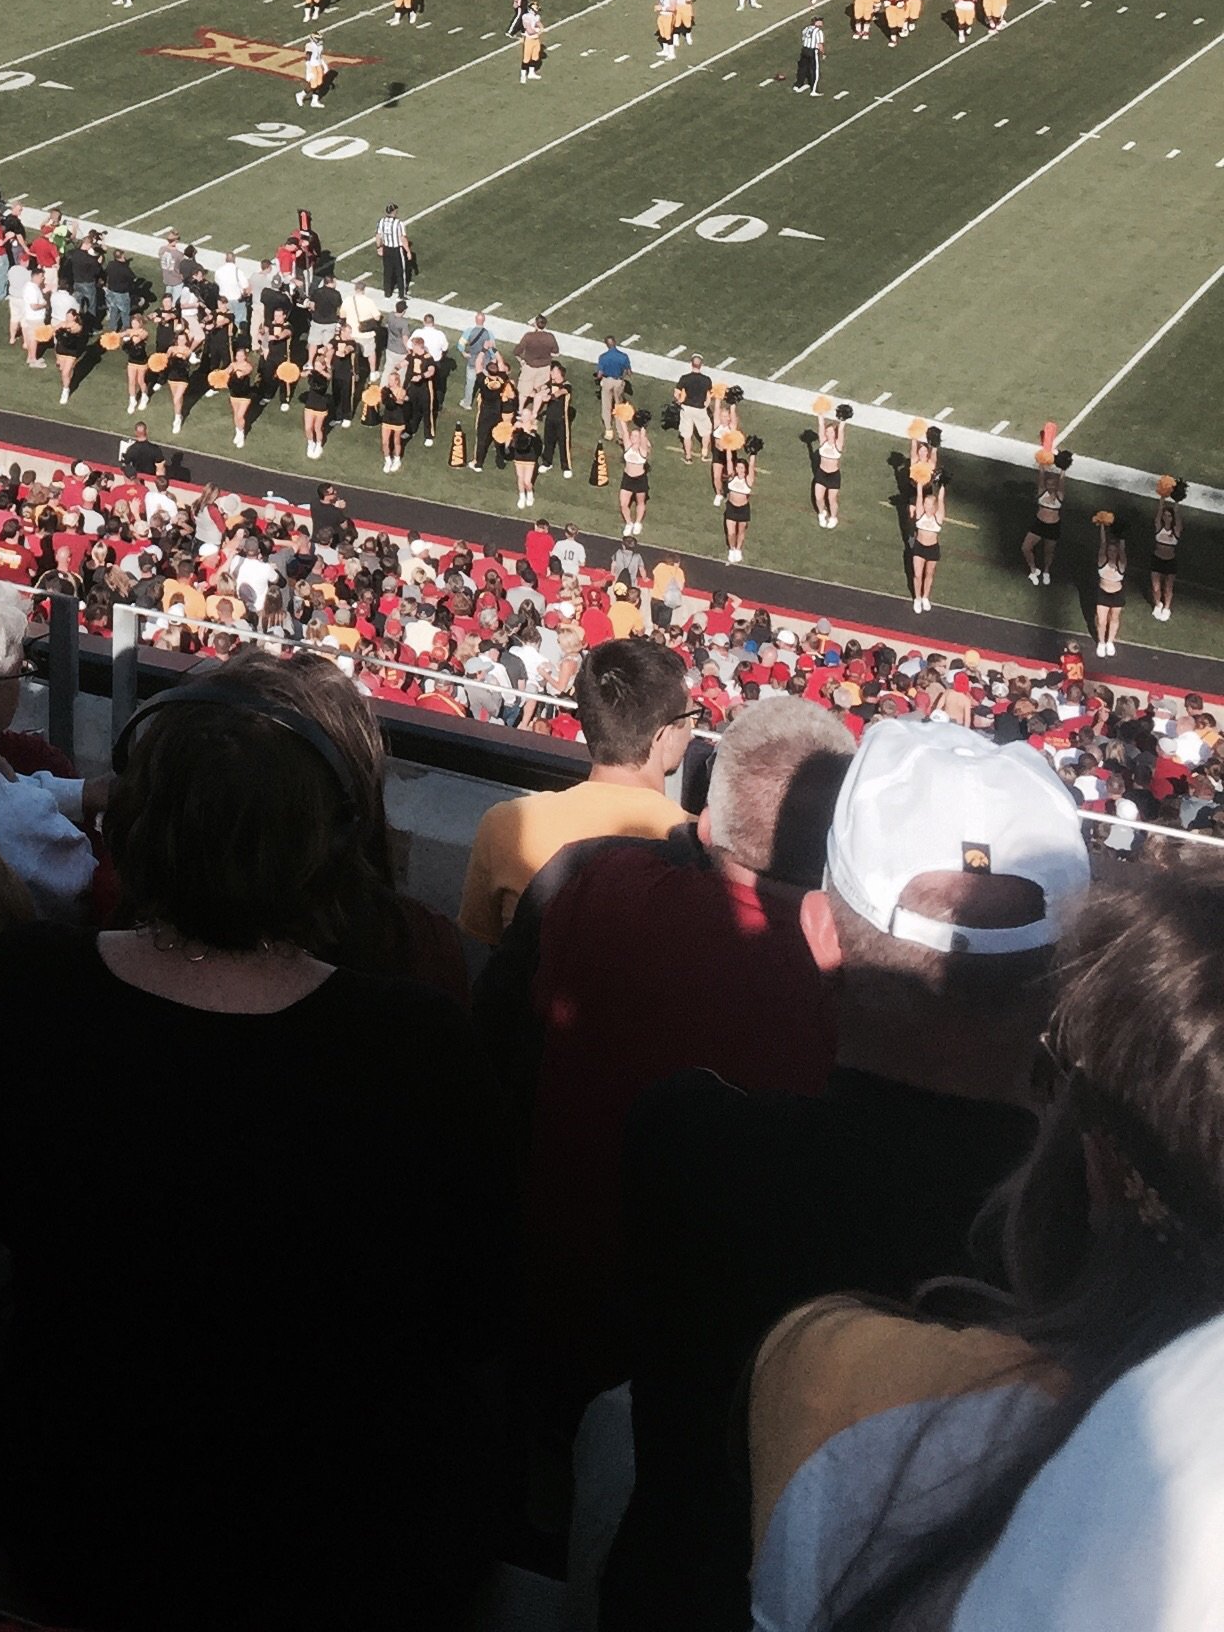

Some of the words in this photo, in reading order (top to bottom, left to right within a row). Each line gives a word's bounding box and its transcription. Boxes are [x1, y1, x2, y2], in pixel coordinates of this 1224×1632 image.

[227, 122, 370, 160] 20
[619, 198, 769, 243] 10
[597, 450, 608, 487] IOWA
[562, 549, 575, 561] 10
